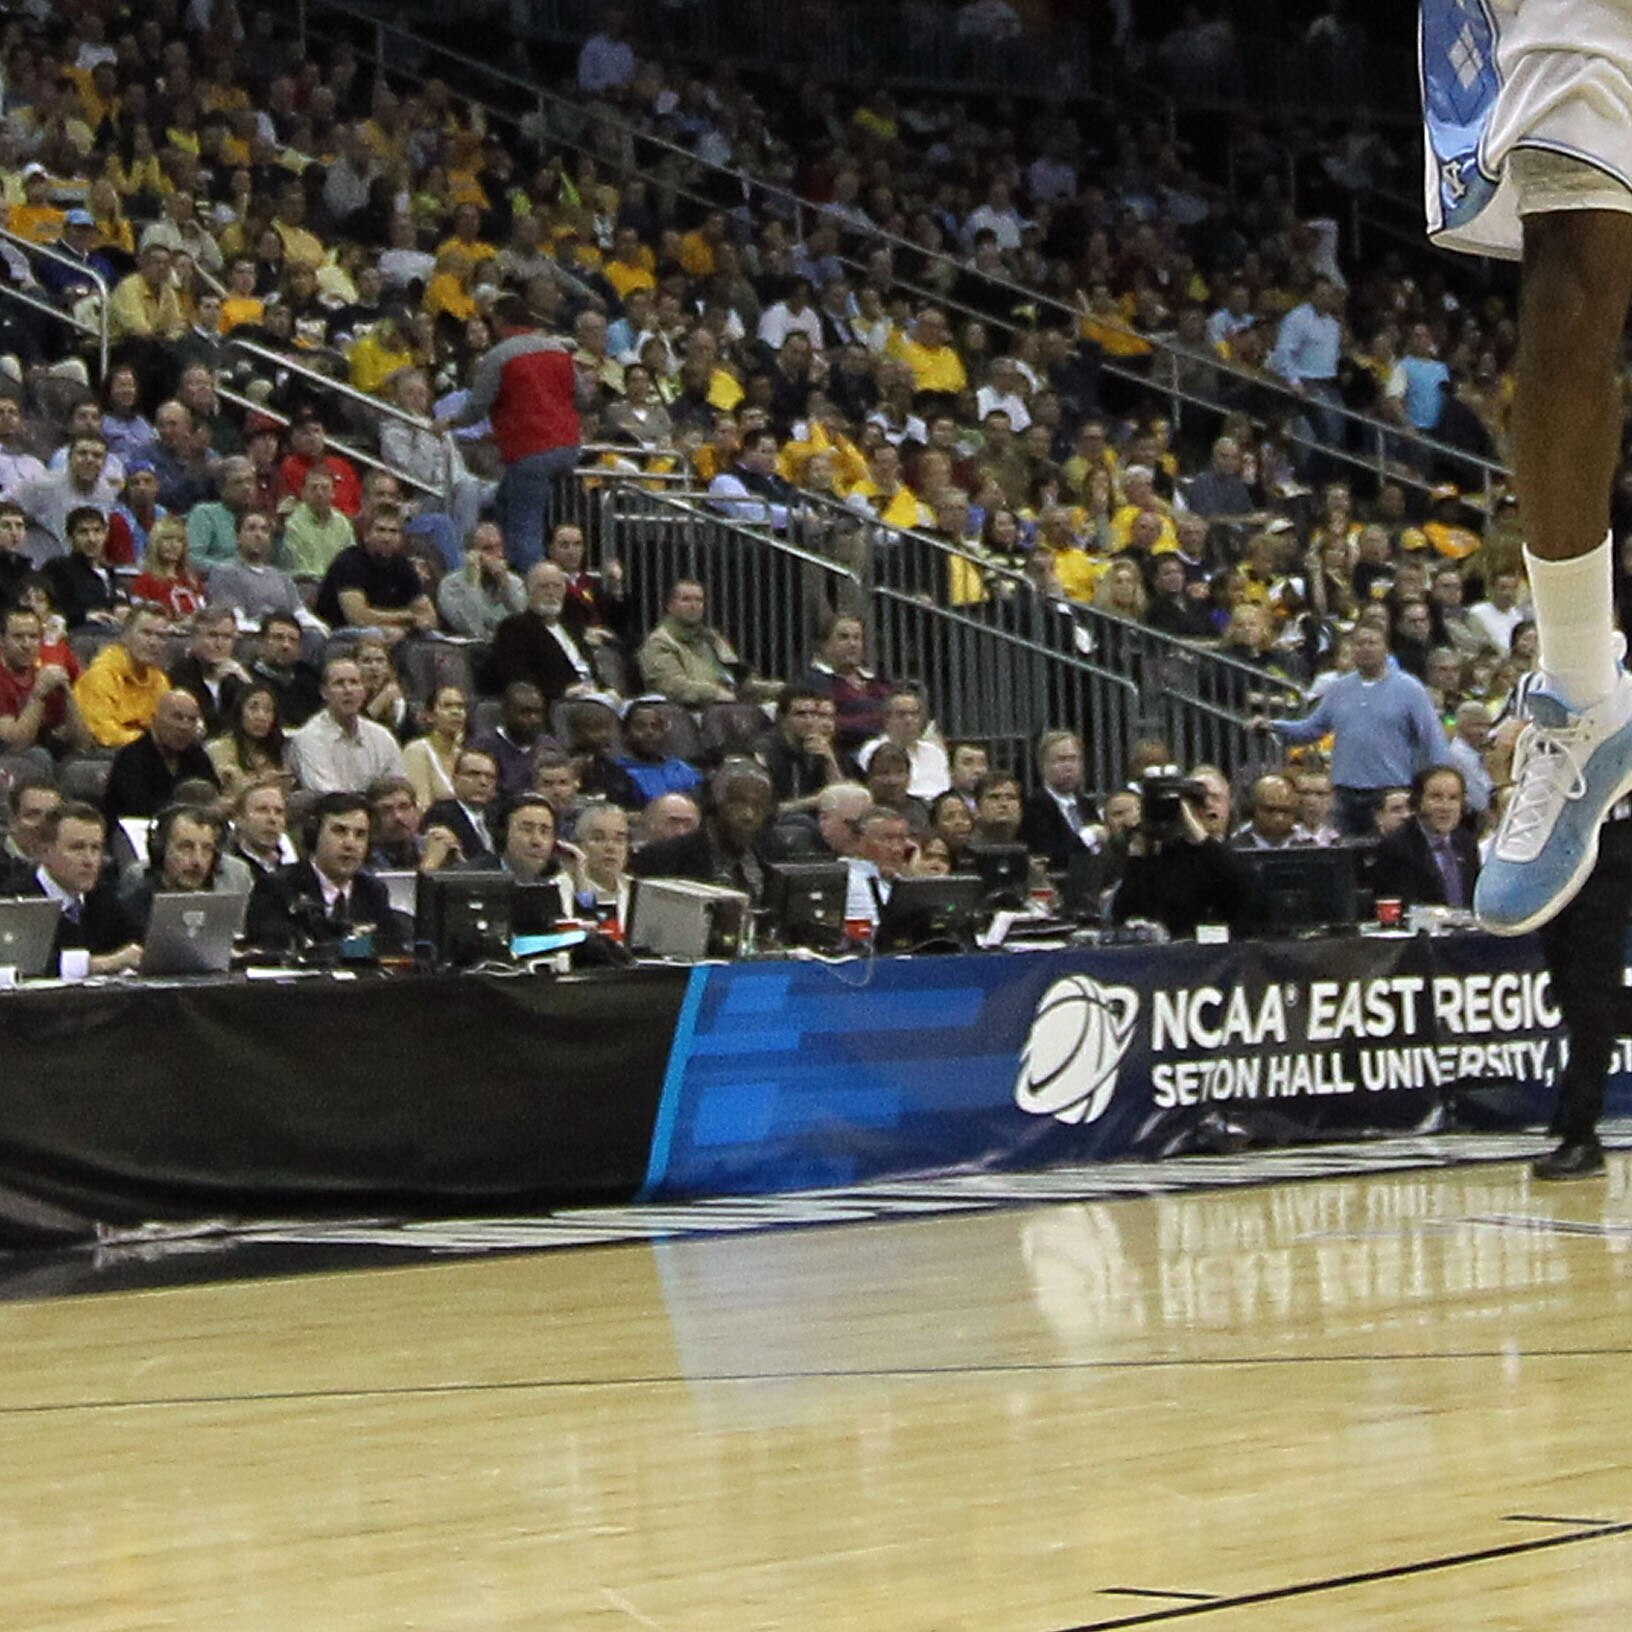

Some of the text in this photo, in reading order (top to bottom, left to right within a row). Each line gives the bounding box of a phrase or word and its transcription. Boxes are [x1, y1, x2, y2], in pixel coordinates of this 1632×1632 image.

[1307, 976, 1424, 1042] EAST
[1152, 1058, 1260, 1109] SETON
[1267, 1052, 1356, 1099] HALL
[1360, 1039, 1554, 1092] UNIVERSITY,
